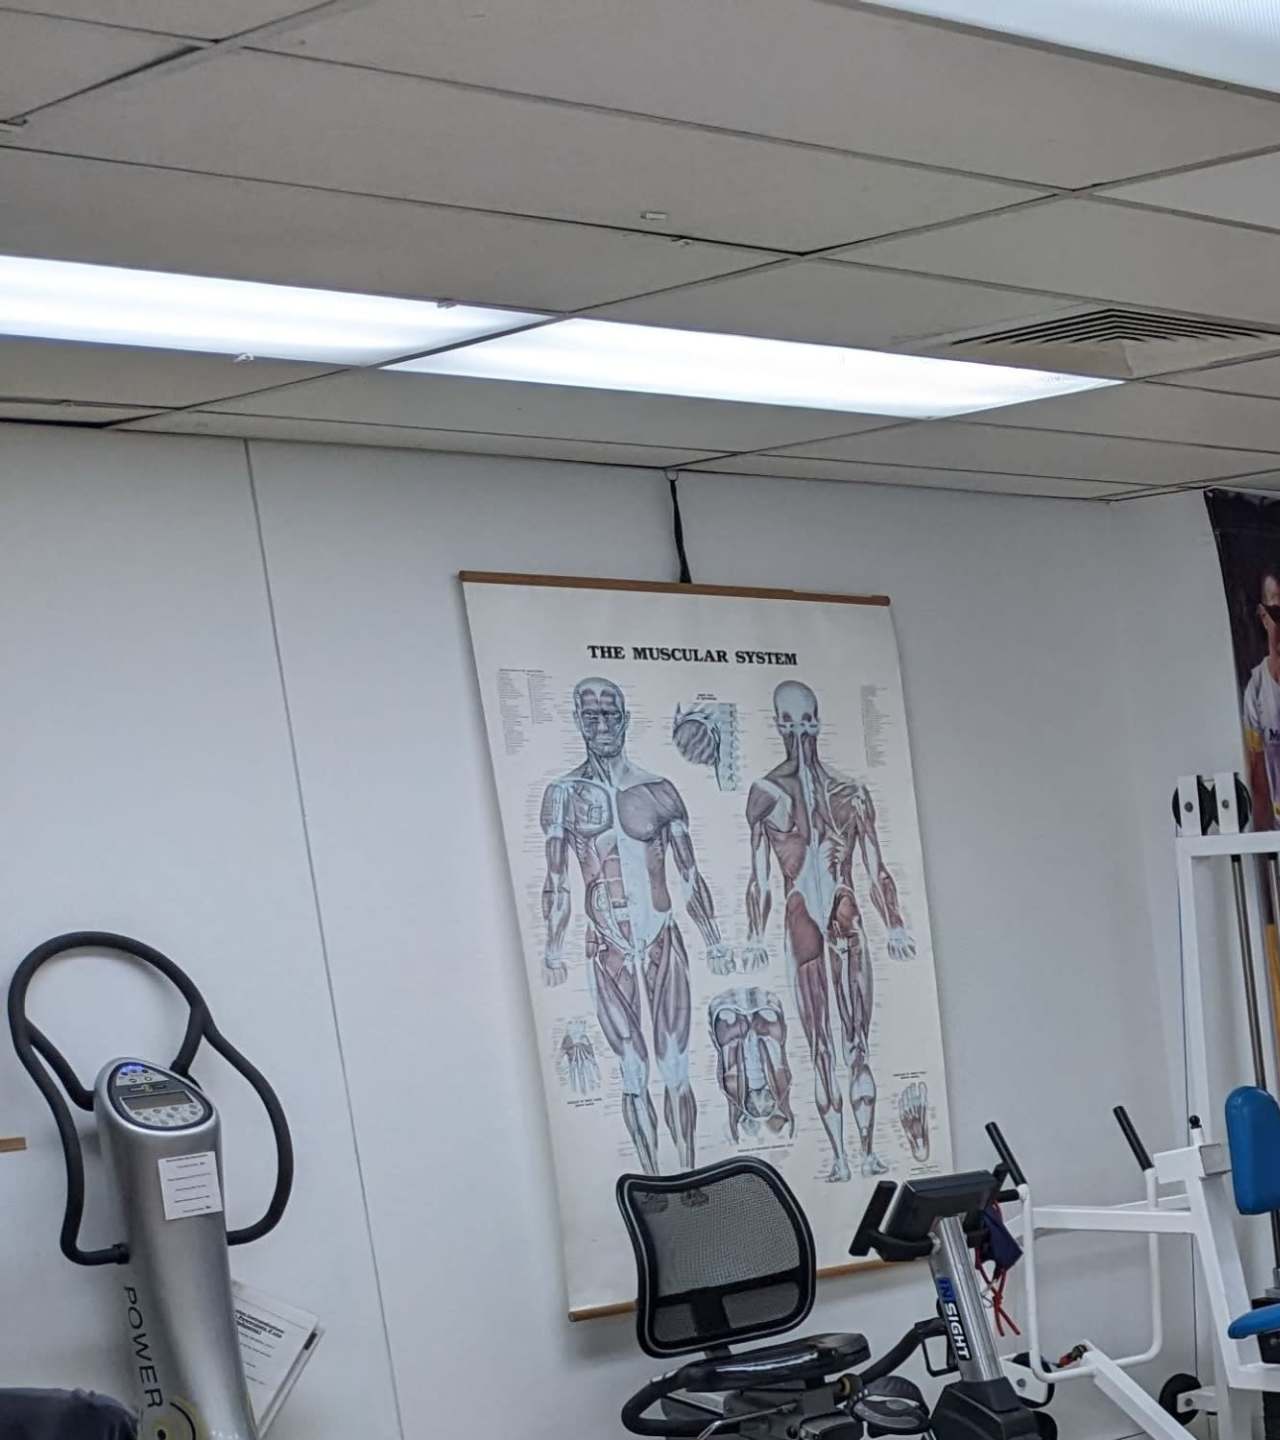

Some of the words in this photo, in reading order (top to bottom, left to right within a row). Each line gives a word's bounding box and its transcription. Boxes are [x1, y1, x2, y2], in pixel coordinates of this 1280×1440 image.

[587, 645, 626, 660] THE
[632, 646, 729, 664] MUSCULAR
[735, 650, 799, 666] SYSTEM
[123, 1285, 164, 1409] POWER
[939, 1278, 971, 1360] INSIGHT
